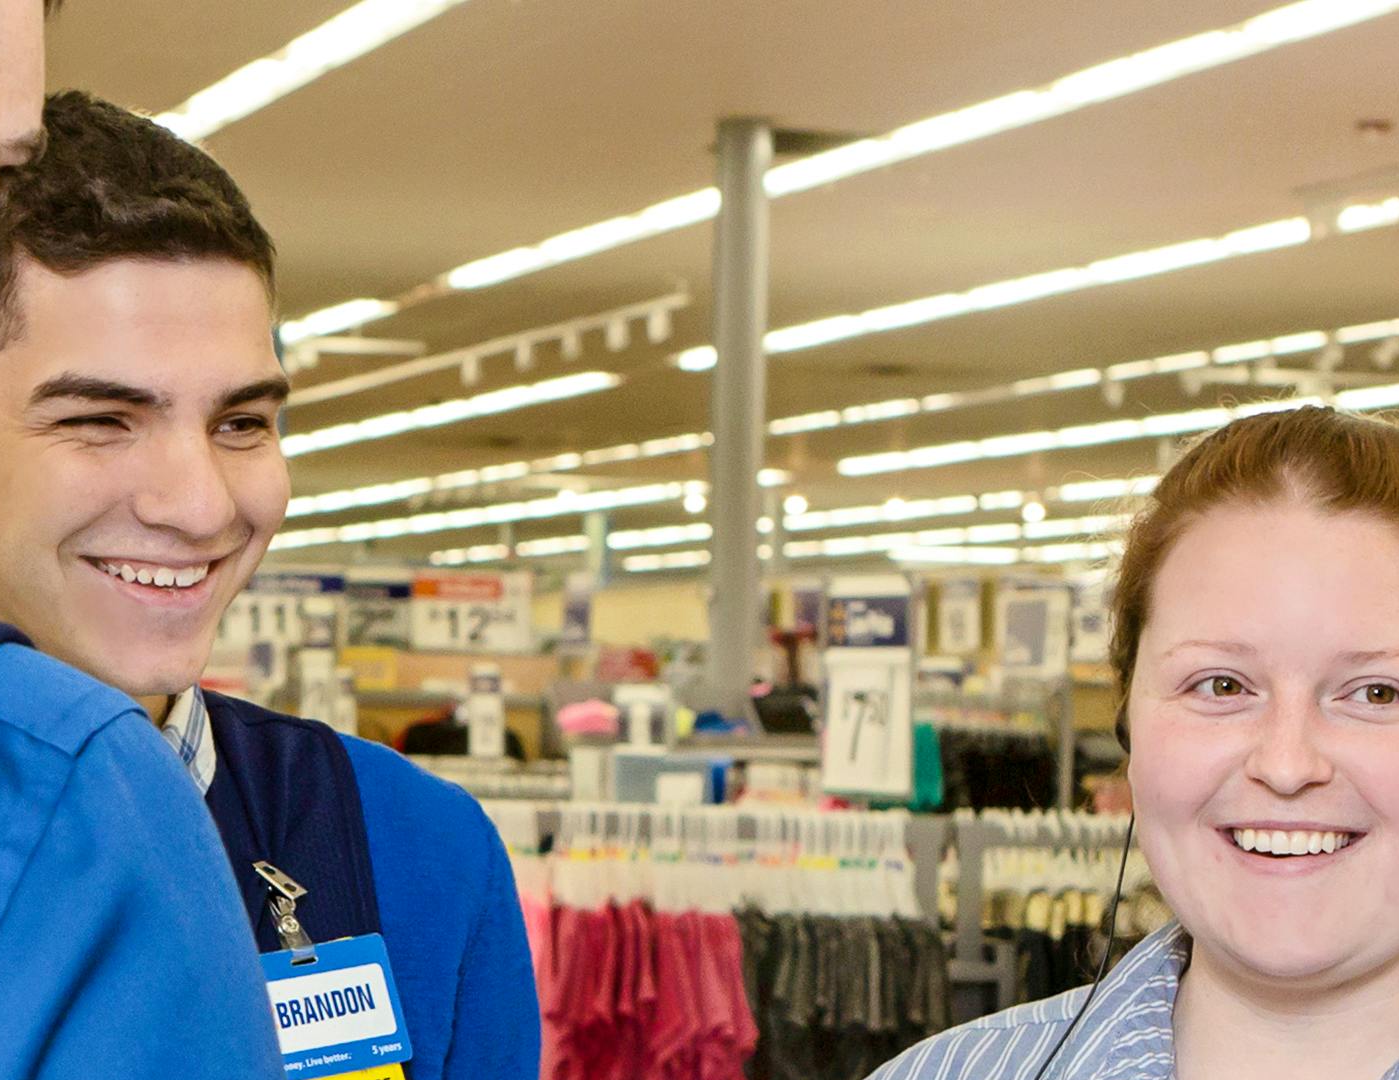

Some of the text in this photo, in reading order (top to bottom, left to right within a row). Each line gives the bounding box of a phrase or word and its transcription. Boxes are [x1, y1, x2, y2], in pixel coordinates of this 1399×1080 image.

[276, 983, 376, 1029] BRANDON
[371, 1042, 403, 1056] 5 years
